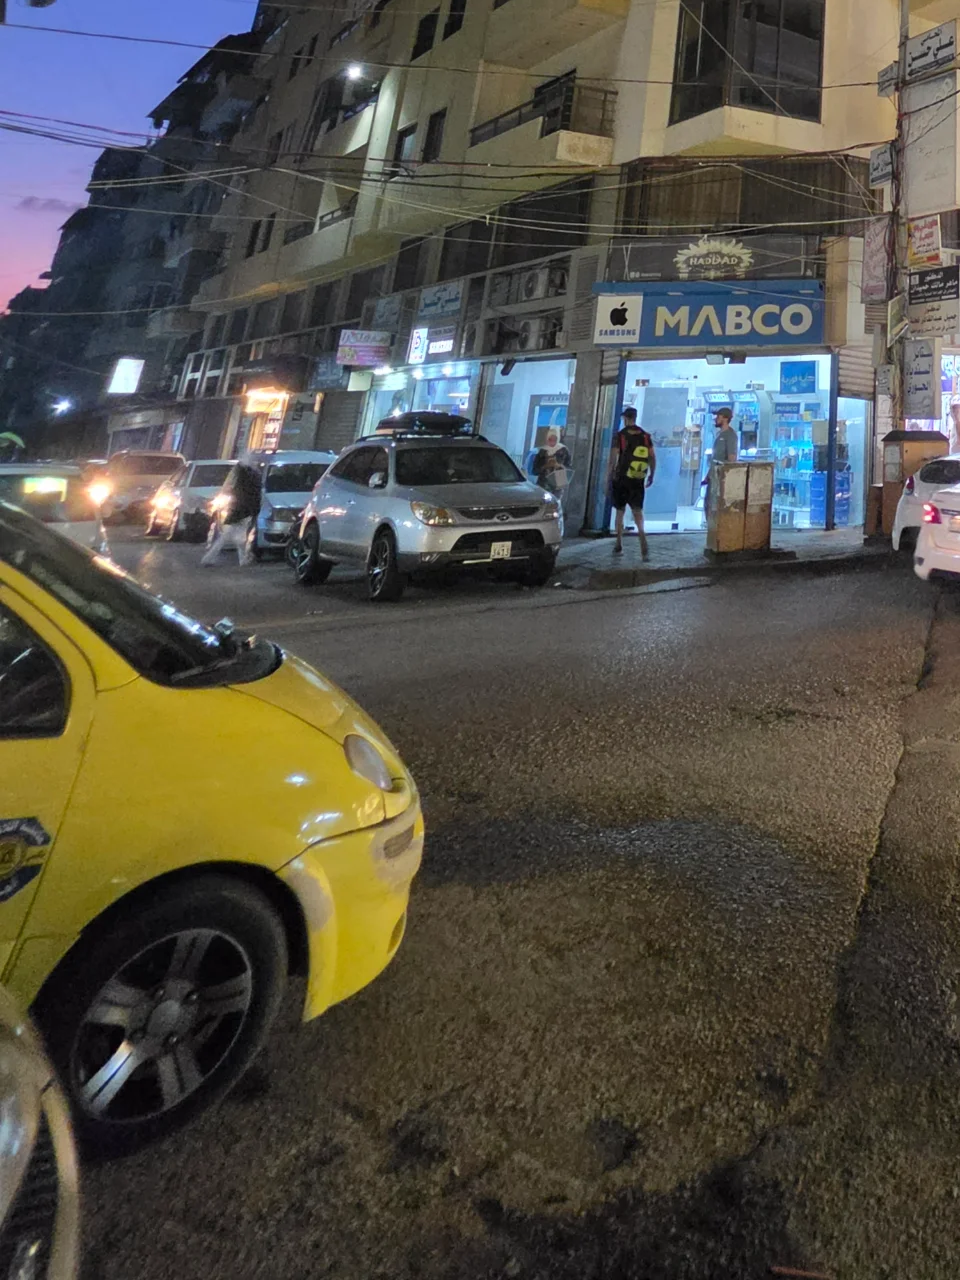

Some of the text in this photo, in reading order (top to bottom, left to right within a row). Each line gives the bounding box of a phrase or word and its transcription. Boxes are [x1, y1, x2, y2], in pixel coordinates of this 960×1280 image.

[908, 35, 954, 67] علي حسن
[689, 254, 738, 265] HADDAD
[924, 272, 943, 282] الدكتور
[910, 284, 929, 293] حميدان
[946, 279, 958, 288] ماهر
[655, 304, 813, 337] MABCO
[599, 329, 636, 337] SAMSUNG
